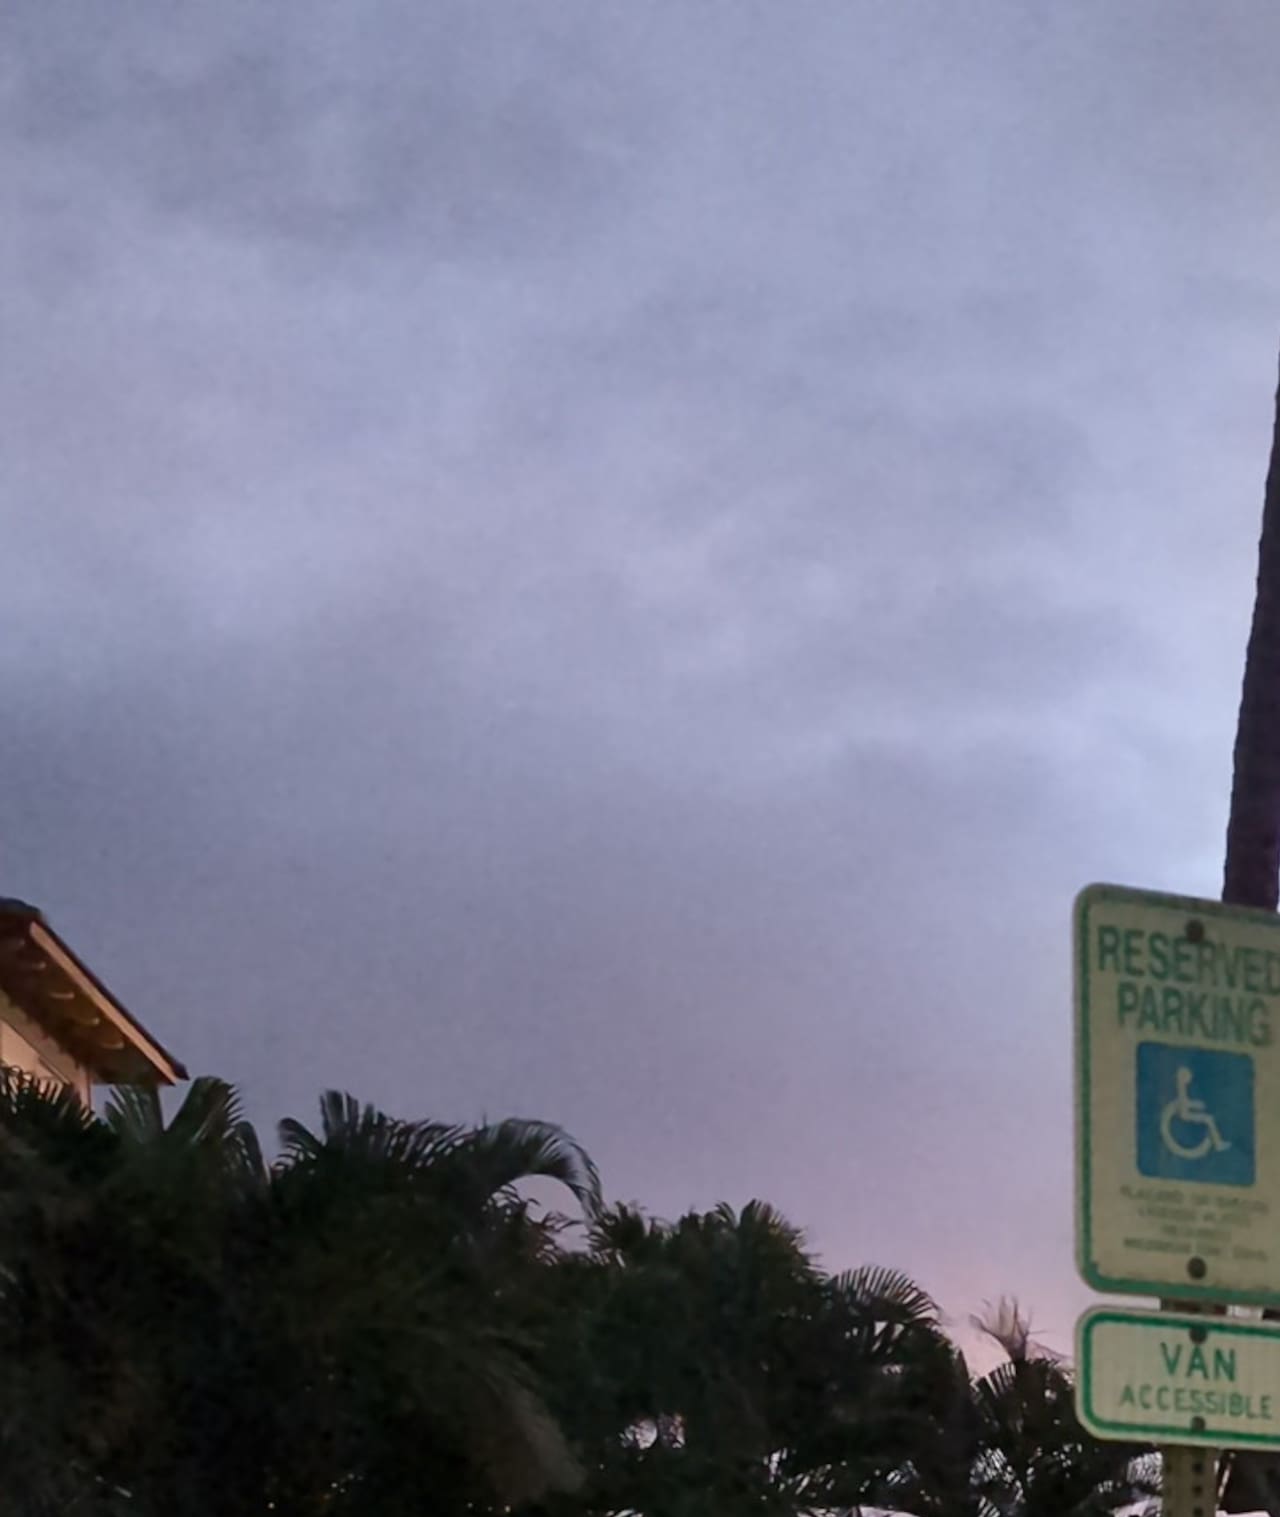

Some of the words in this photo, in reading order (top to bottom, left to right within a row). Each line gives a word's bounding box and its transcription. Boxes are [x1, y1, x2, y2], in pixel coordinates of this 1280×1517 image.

[1117, 981, 1272, 1047] PARKING
[1160, 1341, 1236, 1382] VAN
[1120, 1384, 1273, 1420] ACCESSIBLE
